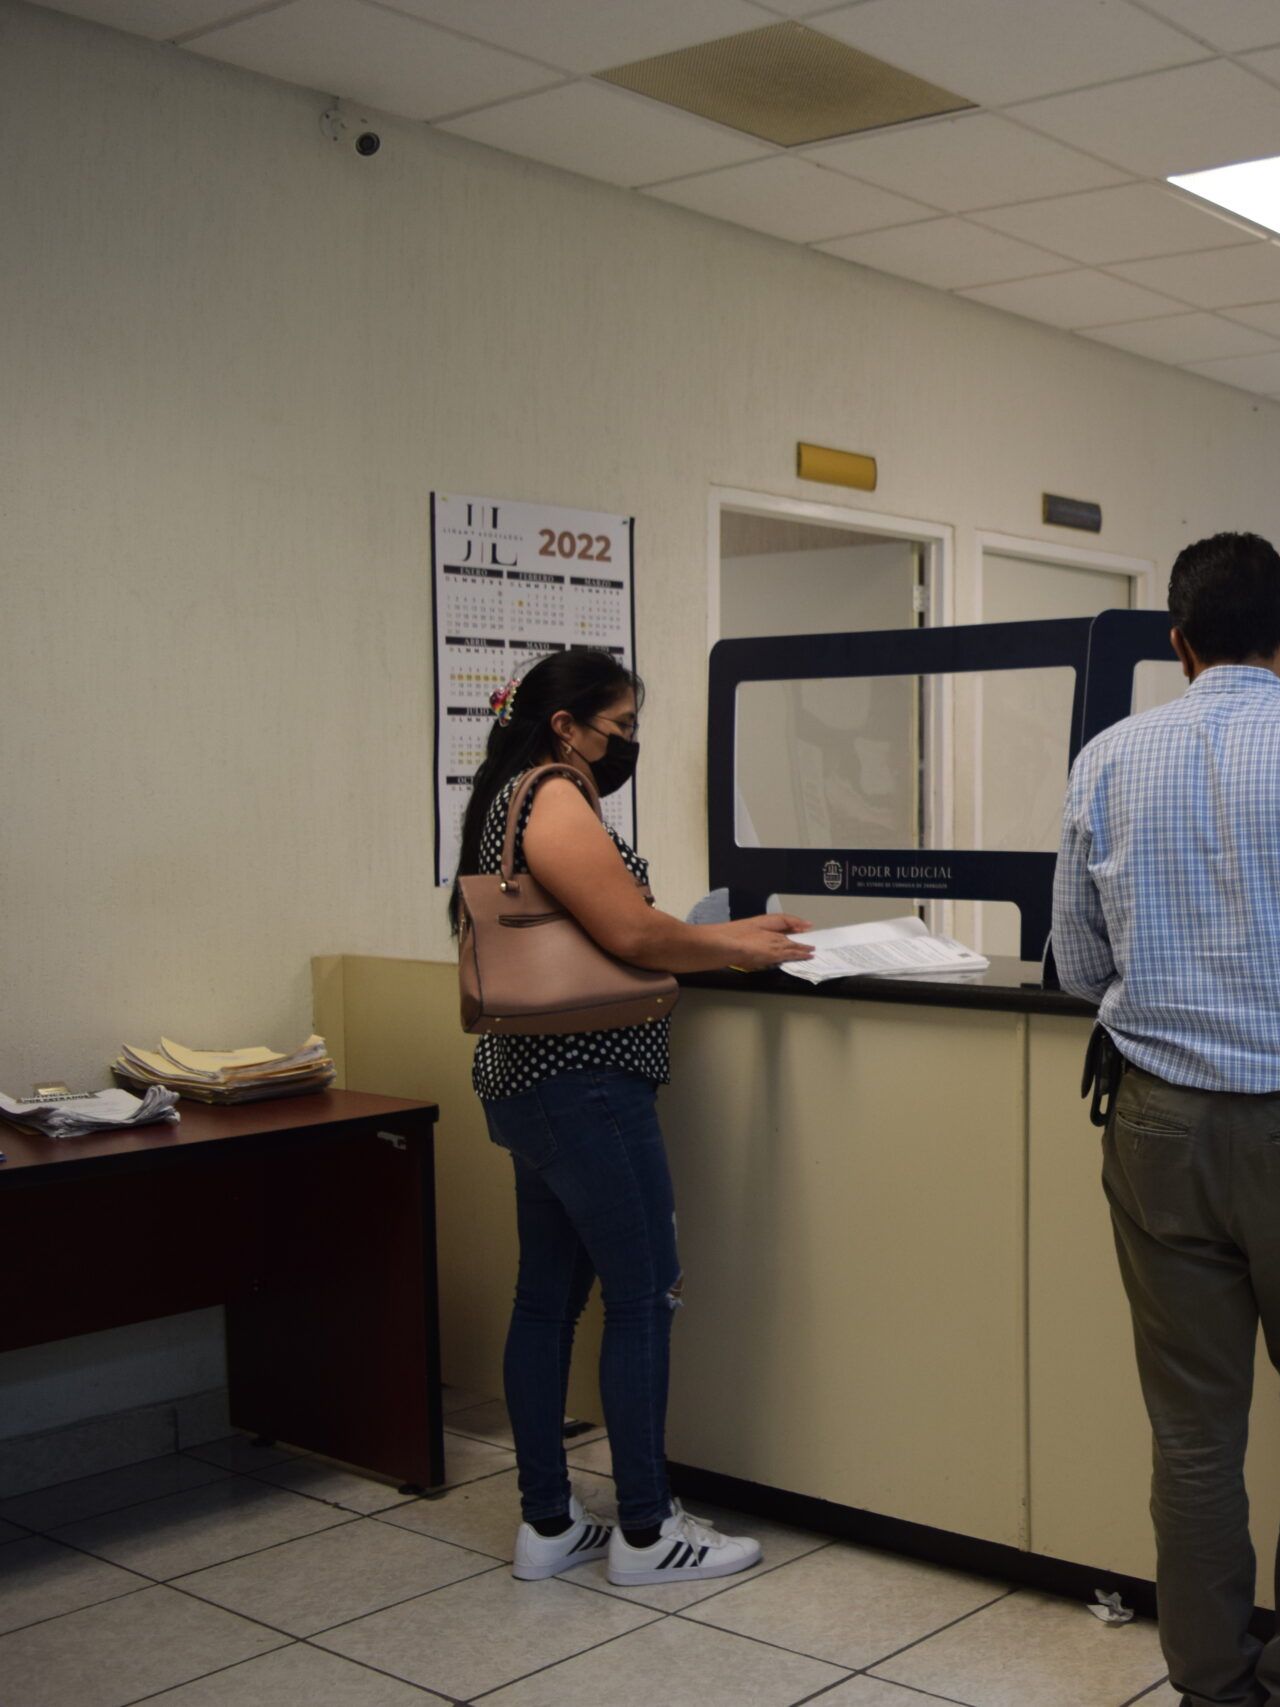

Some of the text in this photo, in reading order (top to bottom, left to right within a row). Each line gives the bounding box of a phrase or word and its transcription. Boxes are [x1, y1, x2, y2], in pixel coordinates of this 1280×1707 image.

[538, 528, 612, 563] 2022
[851, 865, 953, 879] PODER JUDICIAL
